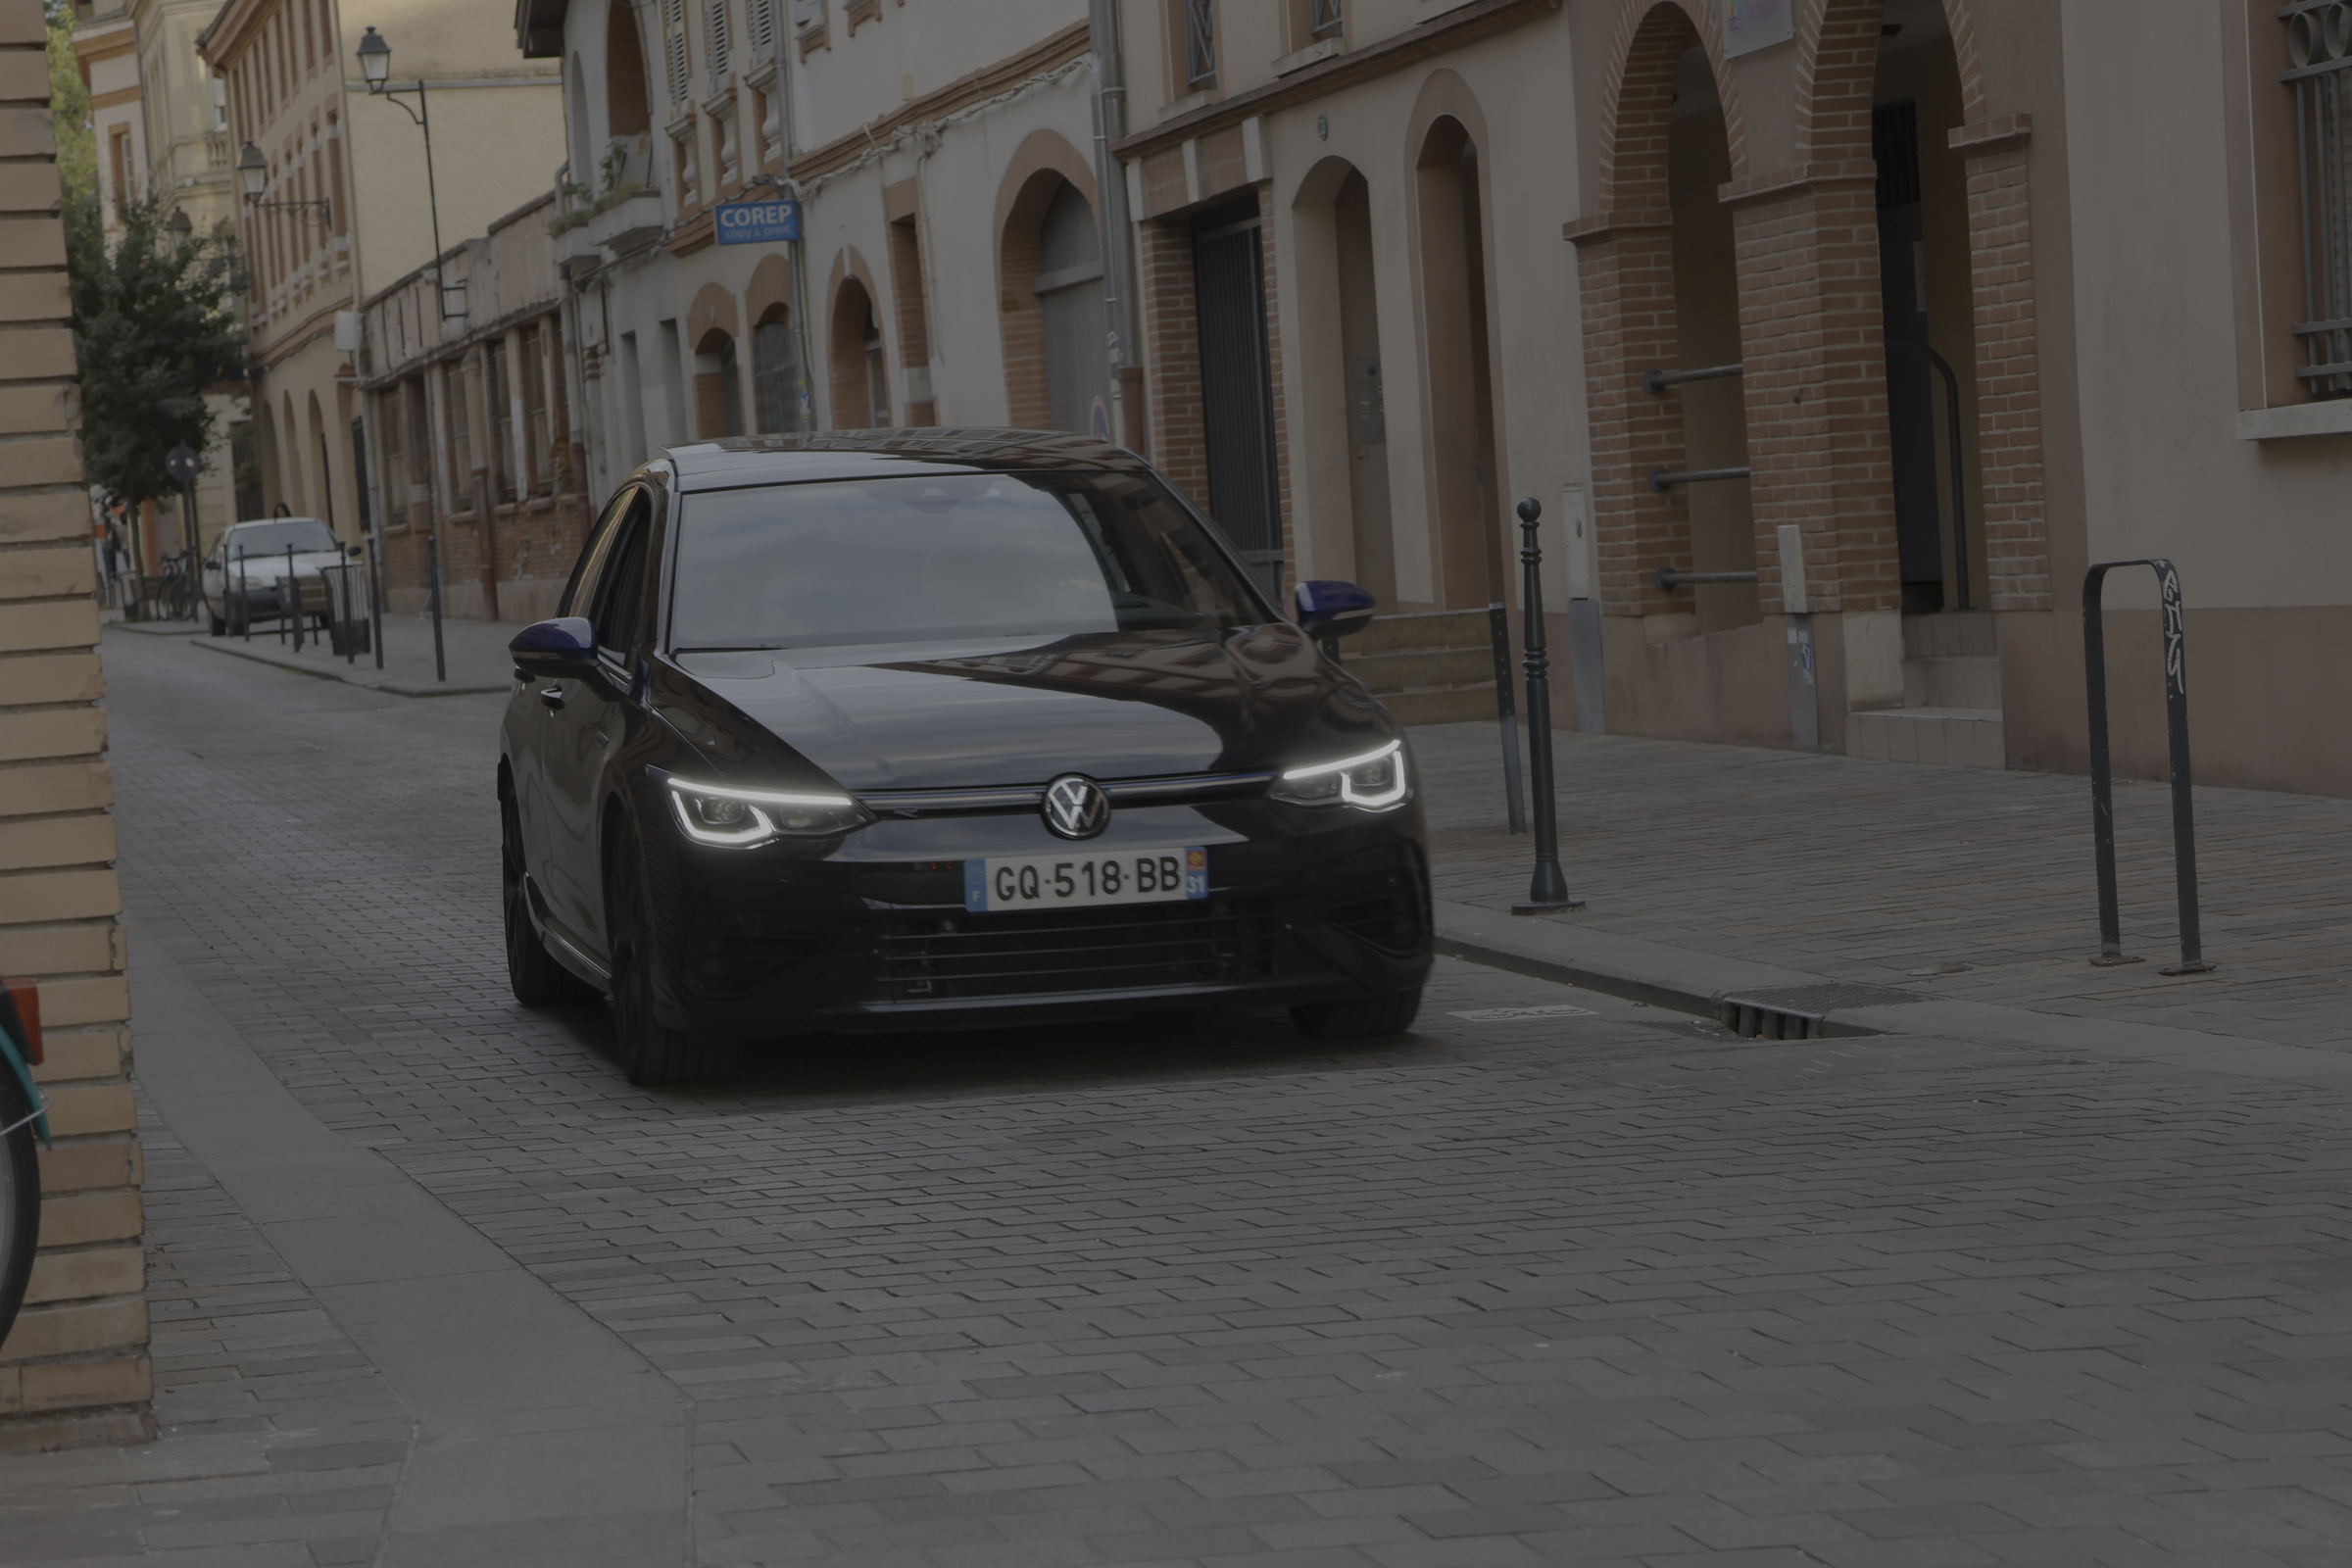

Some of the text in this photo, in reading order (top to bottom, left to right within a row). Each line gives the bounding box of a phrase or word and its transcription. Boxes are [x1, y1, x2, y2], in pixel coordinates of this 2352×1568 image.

[720, 205, 792, 227] COREP
[725, 224, 790, 239] copy & print
[971, 890, 981, 903] F
[1187, 874, 1205, 894] 31
